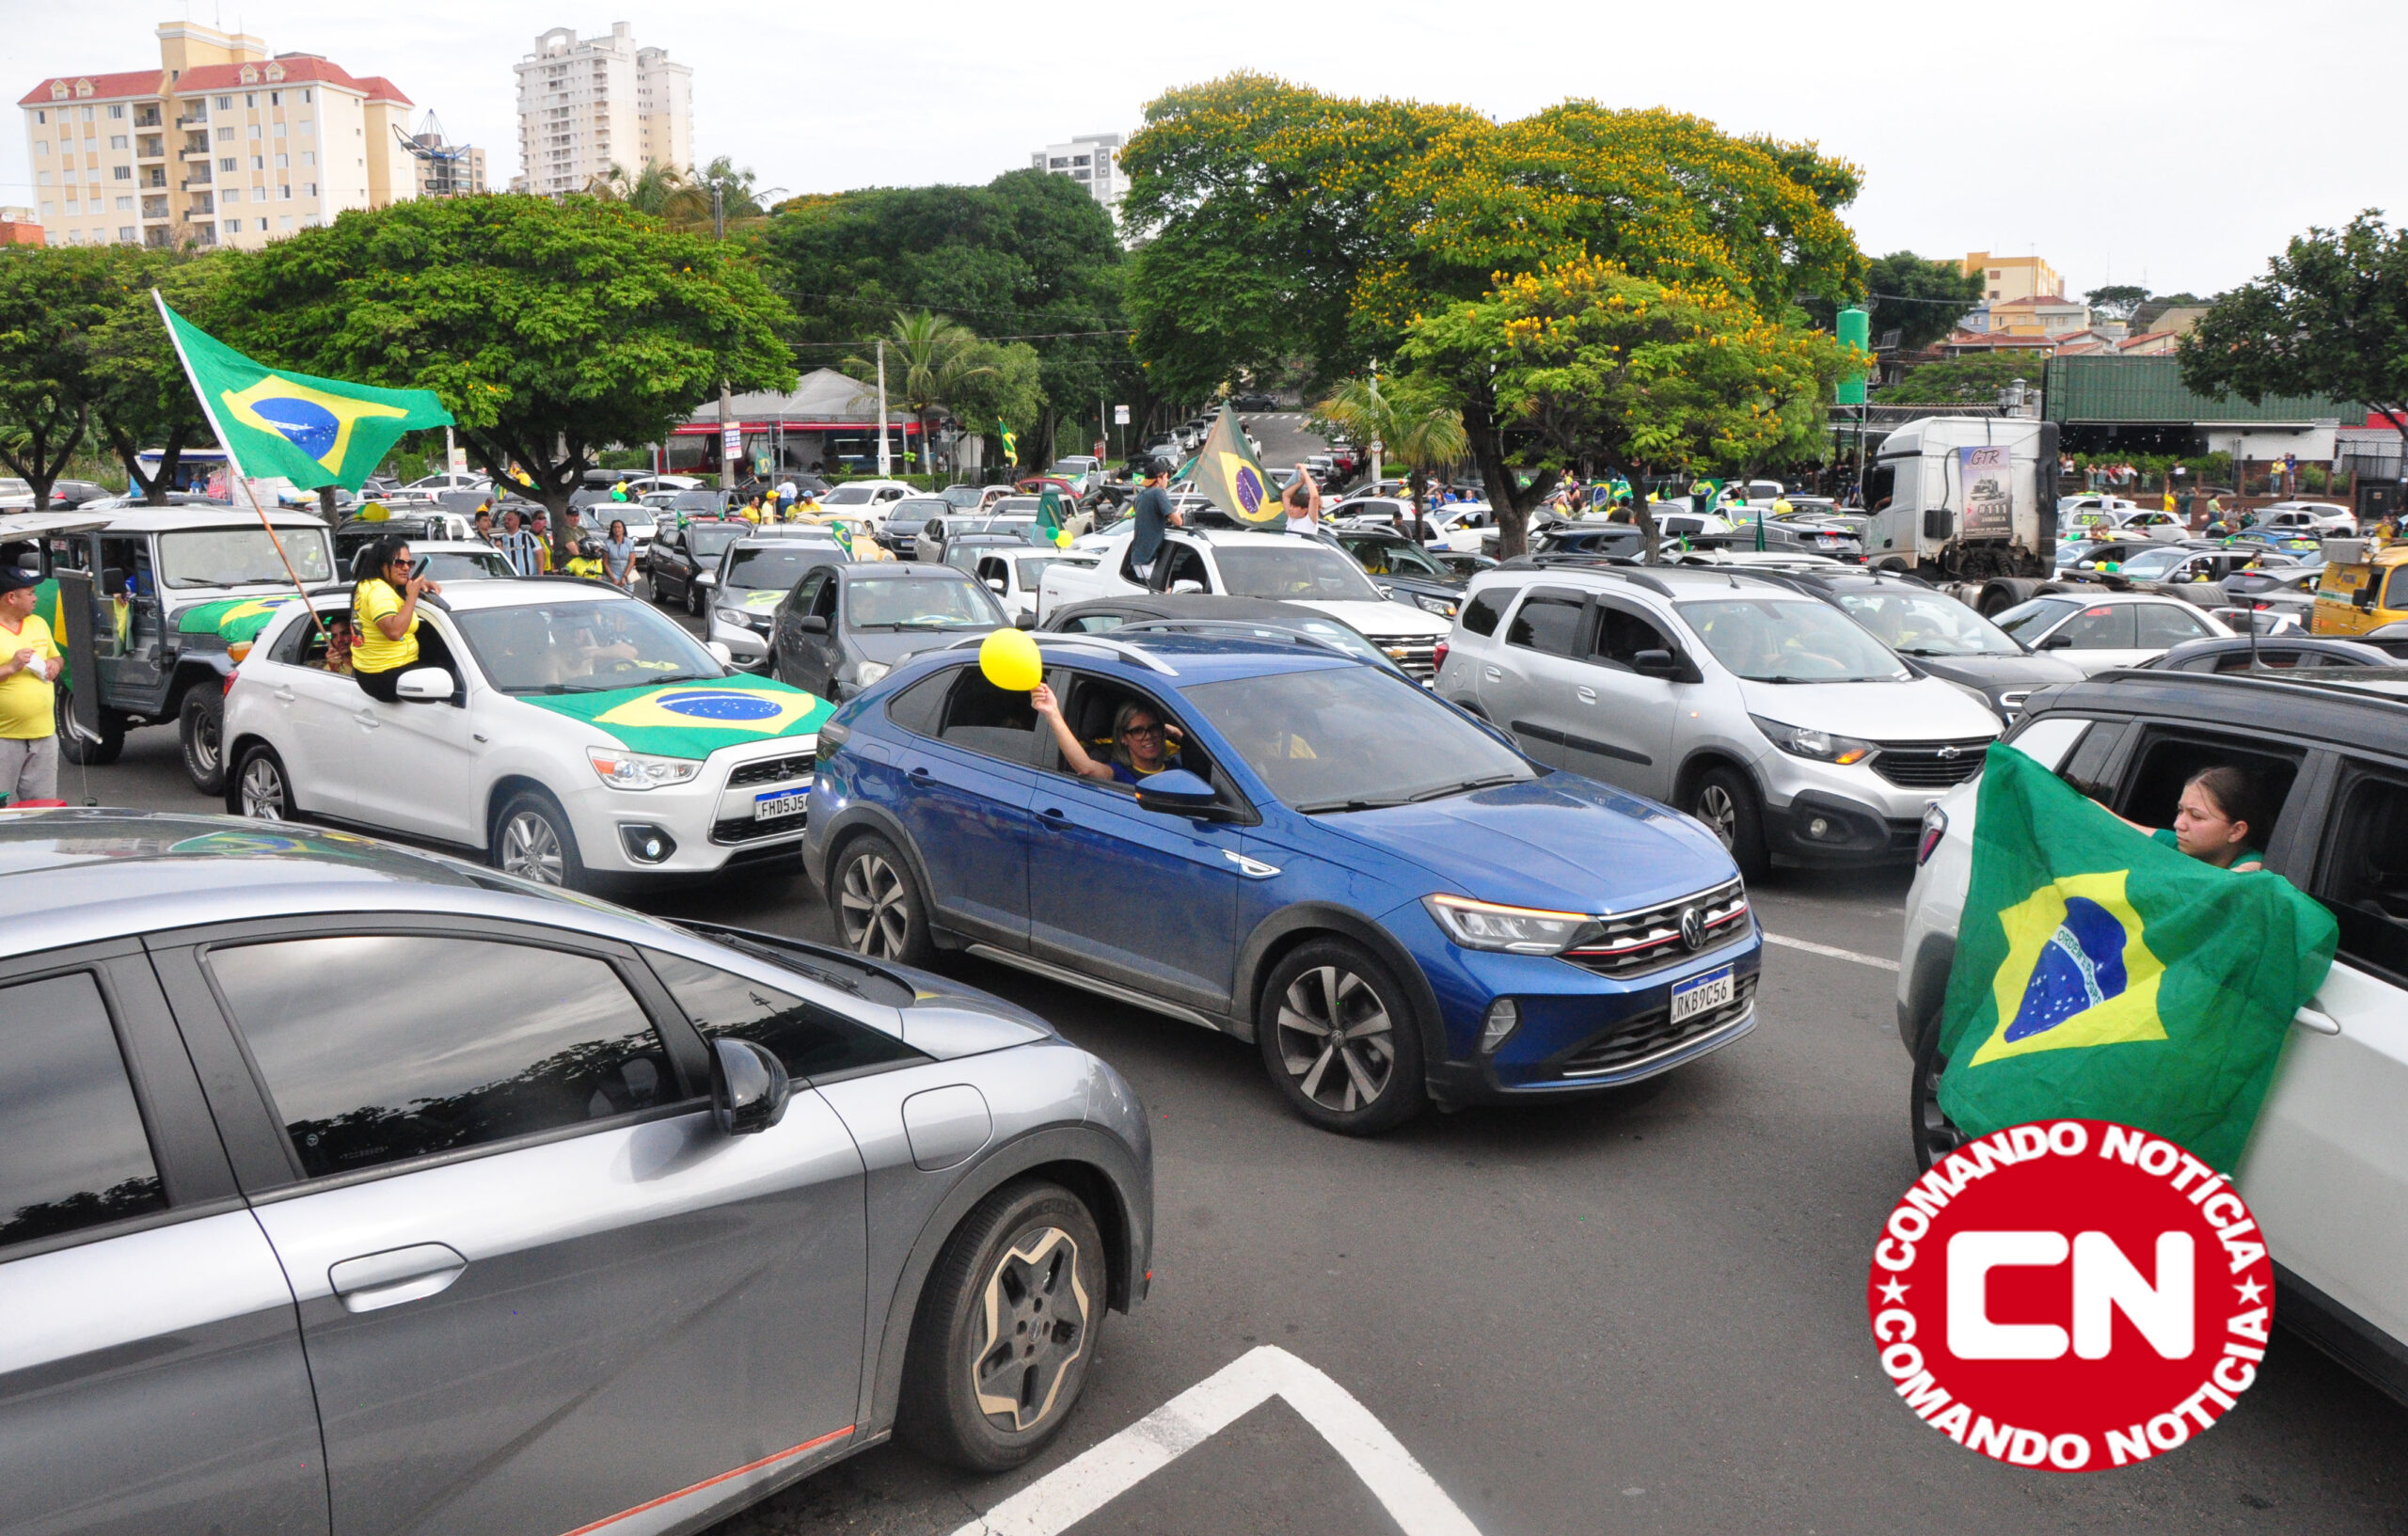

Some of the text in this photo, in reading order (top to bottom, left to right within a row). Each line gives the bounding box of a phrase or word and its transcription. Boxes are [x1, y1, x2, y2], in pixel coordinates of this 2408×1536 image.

[1971, 450, 1999, 466] GTR
[1978, 504, 2007, 515] #111
[2057, 929, 2083, 960] ORDEM
[1677, 979, 1728, 1018] RKB9C56
